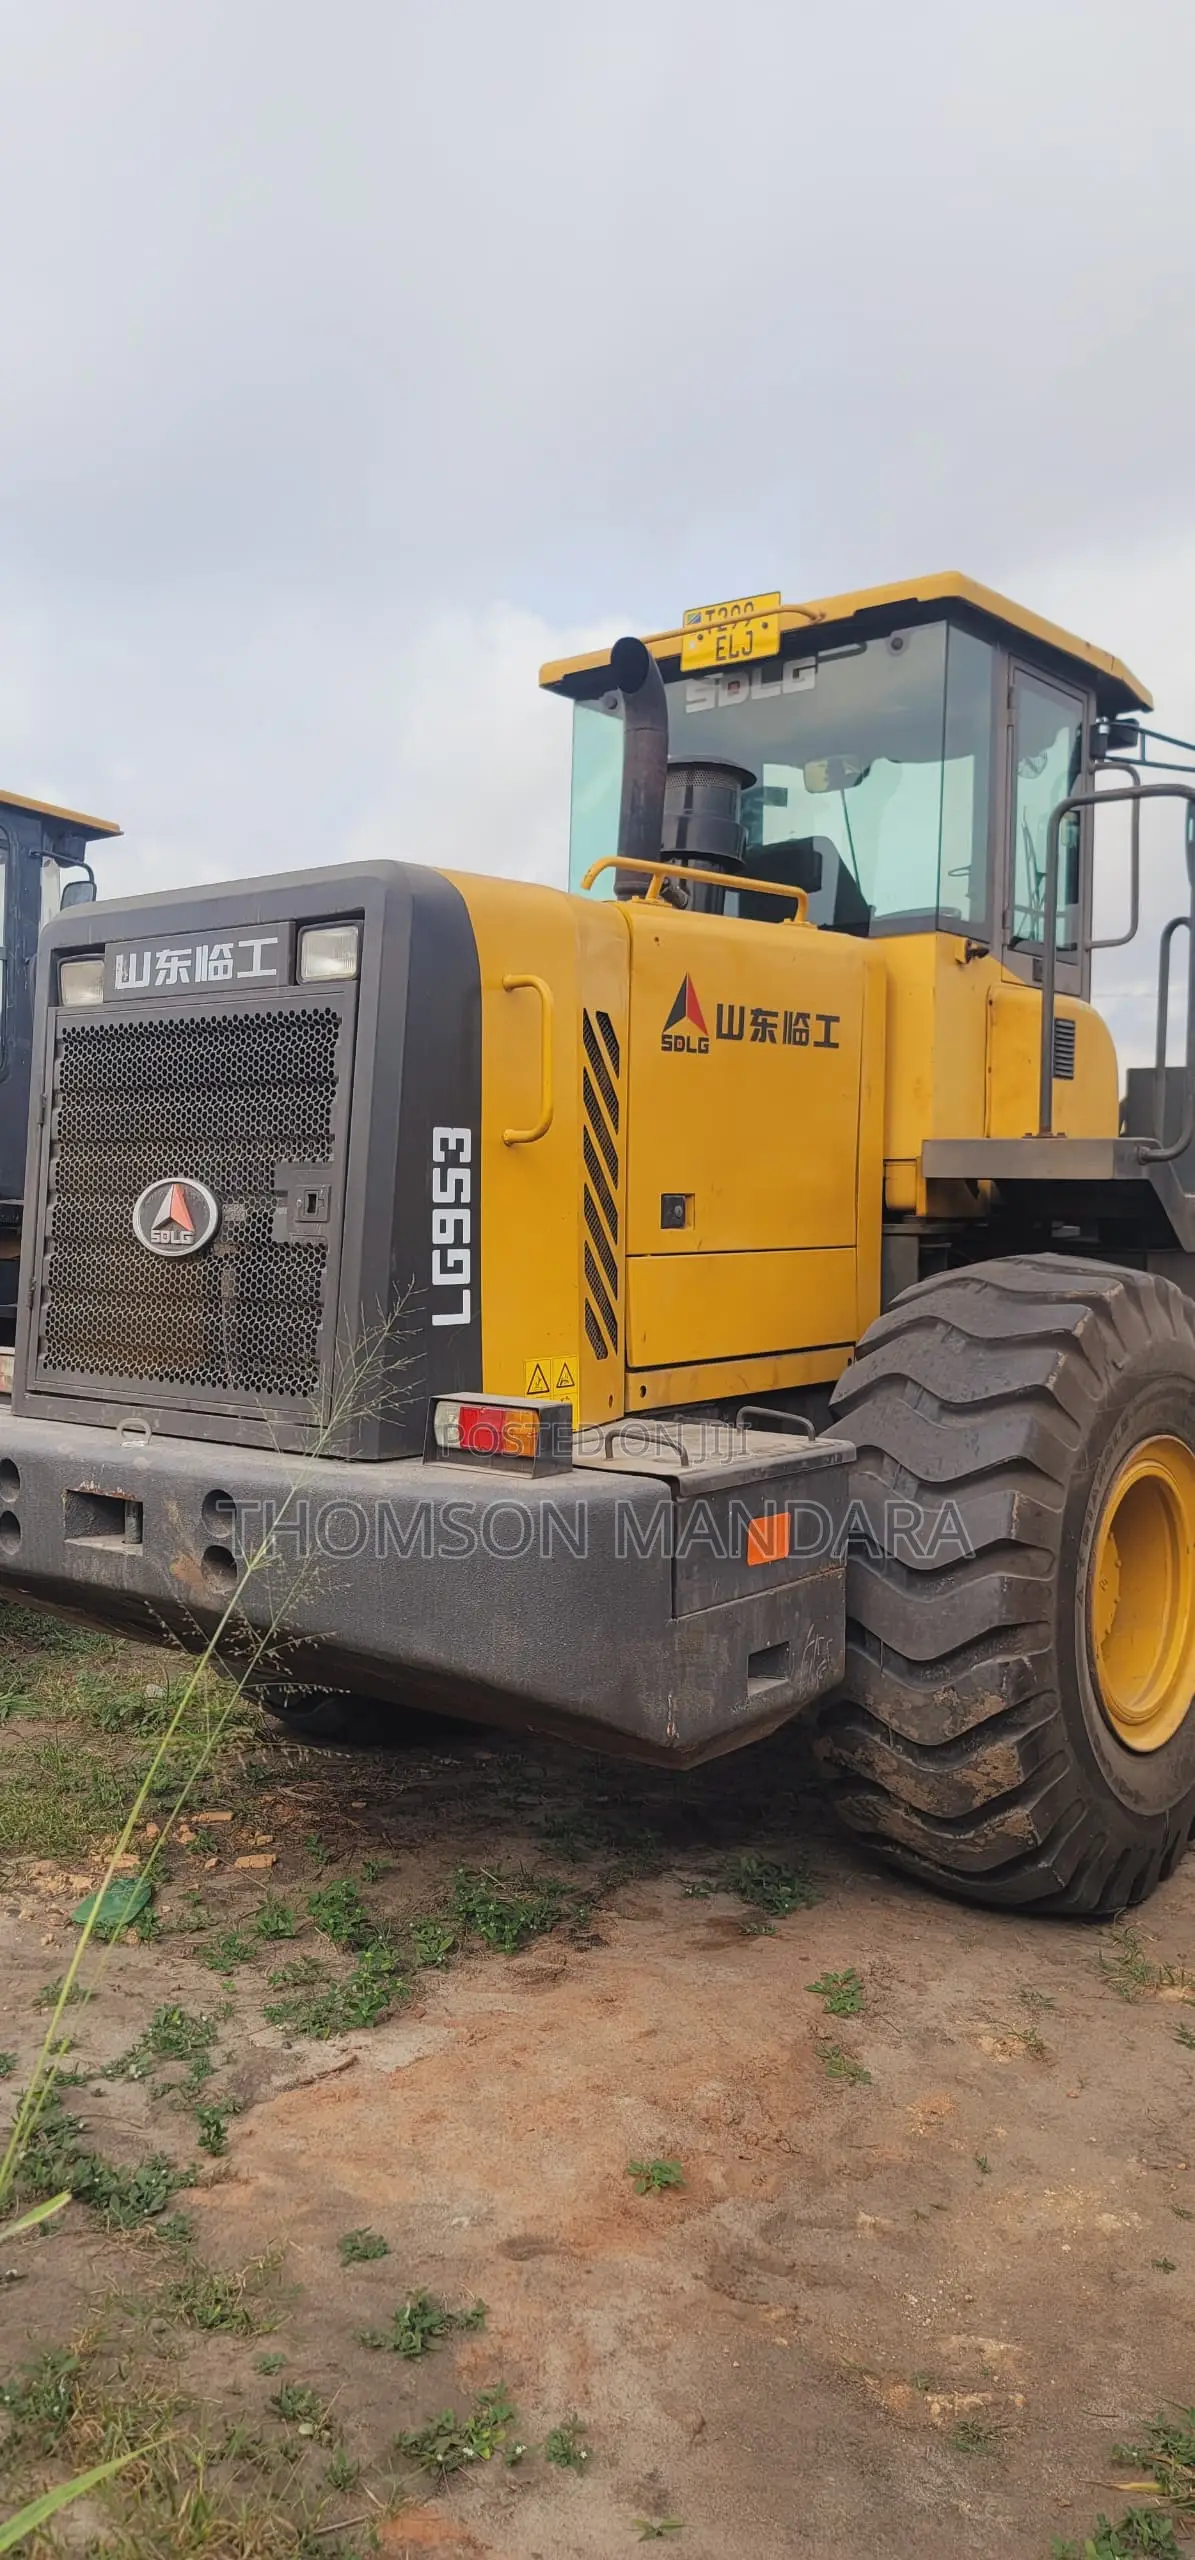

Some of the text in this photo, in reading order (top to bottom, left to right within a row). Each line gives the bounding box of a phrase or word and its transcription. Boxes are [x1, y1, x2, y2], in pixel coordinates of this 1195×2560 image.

[715, 631, 753, 662] ELJ
[685, 656, 816, 714] SDLG
[115, 937, 279, 990] 山东临工
[661, 1033, 709, 1054] SDLG
[716, 1003, 840, 1049] 山东临工
[150, 1229, 195, 1245] SDLG
[432, 1127, 471, 1326] LG953
